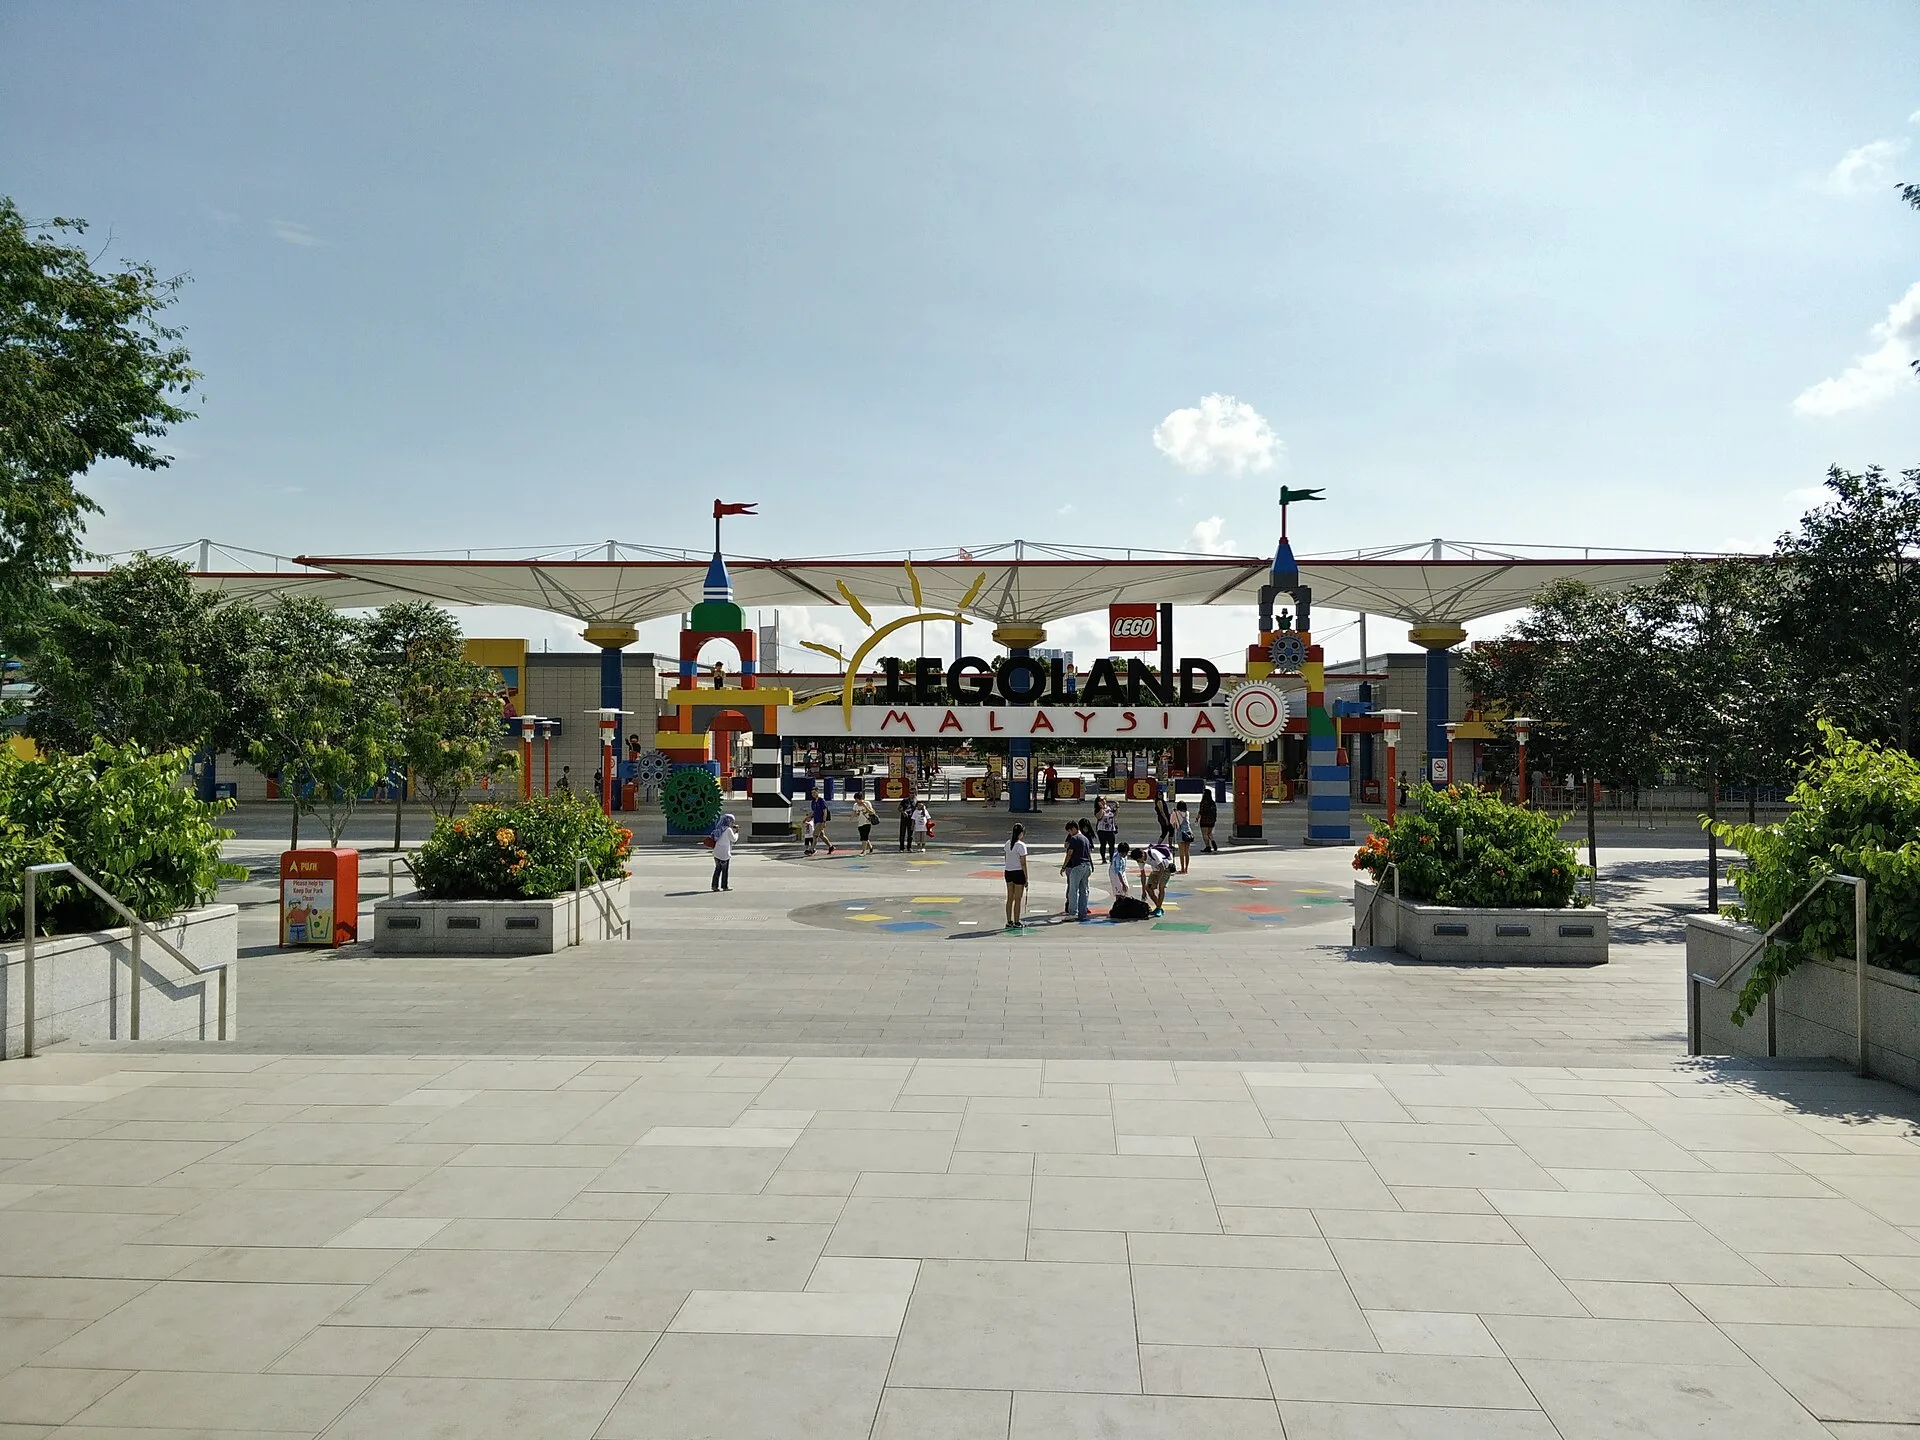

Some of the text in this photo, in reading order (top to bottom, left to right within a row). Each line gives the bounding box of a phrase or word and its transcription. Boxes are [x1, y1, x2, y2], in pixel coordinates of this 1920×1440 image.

[1112, 617, 1155, 638] LEGO
[886, 655, 1221, 704] LEGOLAND
[880, 709, 1216, 734] MALAYSIA
[300, 862, 318, 871] PUSH
